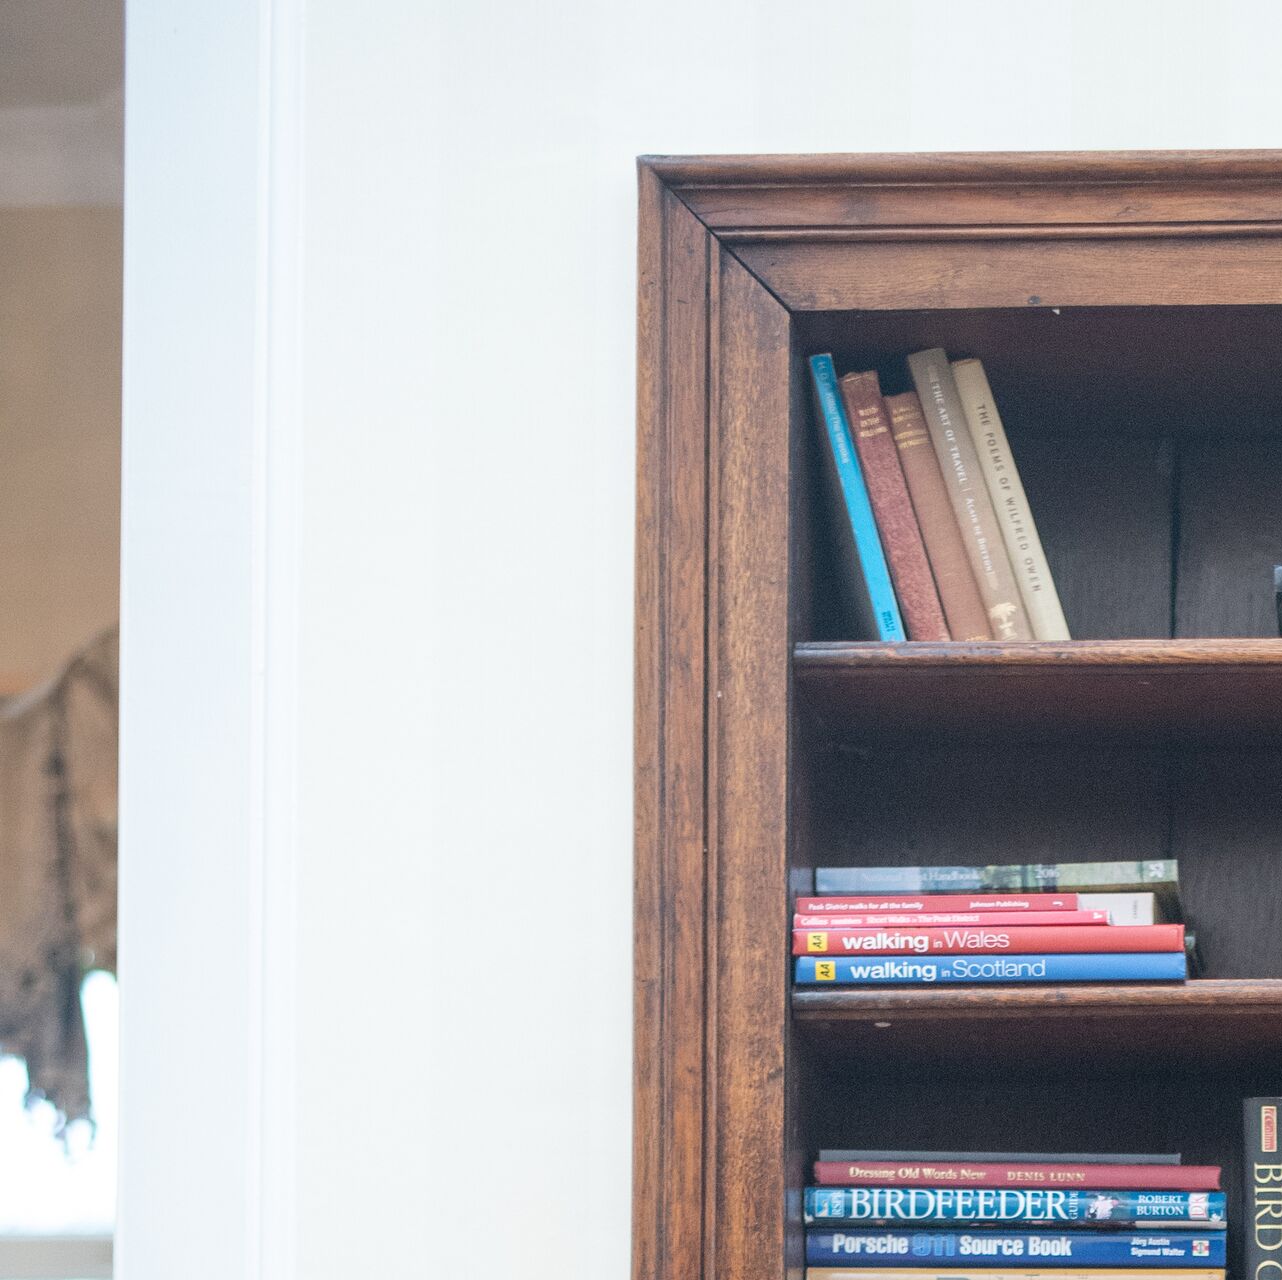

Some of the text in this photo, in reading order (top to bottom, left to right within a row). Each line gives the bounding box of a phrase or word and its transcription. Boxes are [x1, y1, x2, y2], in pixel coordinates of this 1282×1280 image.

[977, 403, 1041, 592] THE POEMS OF WILFRED OWEN
[842, 931, 1010, 953] walking in Wales
[850, 959, 1047, 982] walking in Scotland
[849, 1166, 987, 1181] Dressing Old Words New
[1007, 1171, 1086, 1183] DENIS LUNN
[848, 1187, 1071, 1220] BIRDFEEDER
[1135, 1205, 1185, 1217] BURTON
[1137, 1194, 1184, 1206] ROBERT
[831, 1233, 1073, 1257] Porsche 911 Source Book
